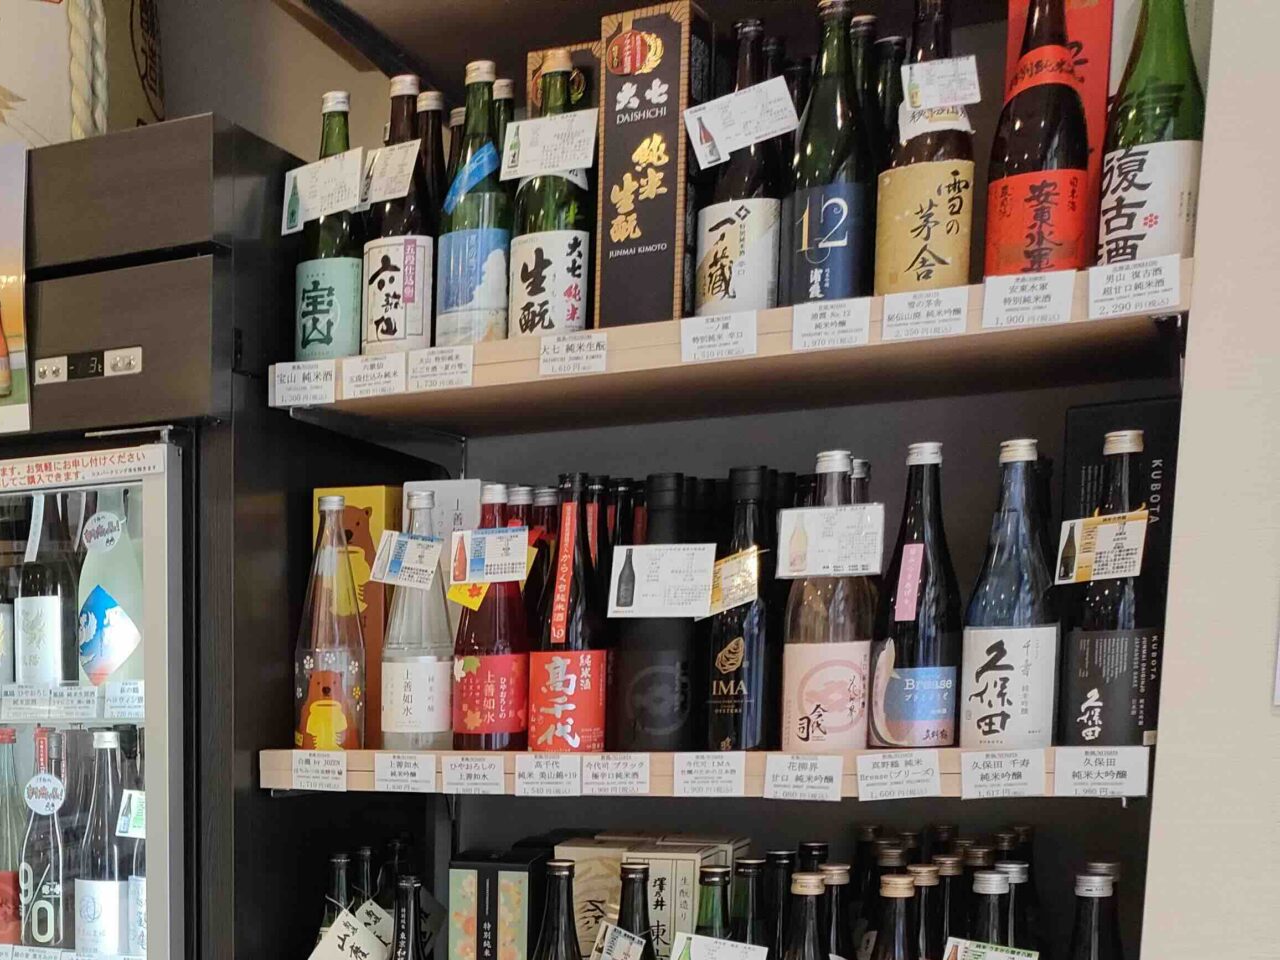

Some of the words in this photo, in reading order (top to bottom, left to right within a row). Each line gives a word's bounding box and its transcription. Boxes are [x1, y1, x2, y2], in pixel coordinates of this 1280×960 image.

[616, 105, 668, 125] DAISHICHI
[944, 169, 970, 236] 雪の
[1098, 148, 1153, 268] 復古酒
[565, 236, 582, 280] 大七
[609, 246, 636, 258] JUNMAI
[637, 242, 668, 253] KIMOTO
[1105, 272, 1126, 285] 男山
[300, 280, 336, 350] 宝山
[563, 283, 581, 322] 純米
[1149, 458, 1164, 526] KUBOTA
[401, 669, 414, 718] 上善如水
[482, 671, 496, 724] 上善如水
[711, 680, 749, 696] IMA
[968, 638, 1016, 738] 久保田
[1076, 688, 1104, 742] 久保田
[449, 761, 497, 772] ひやおろしの
[533, 759, 561, 770] 高千代
[972, 759, 1004, 770] 久保田
[979, 770, 1023, 782] 純米吟醸
[1071, 769, 1128, 781] 純米大吟醸
[1083, 757, 1117, 768] 久保田
